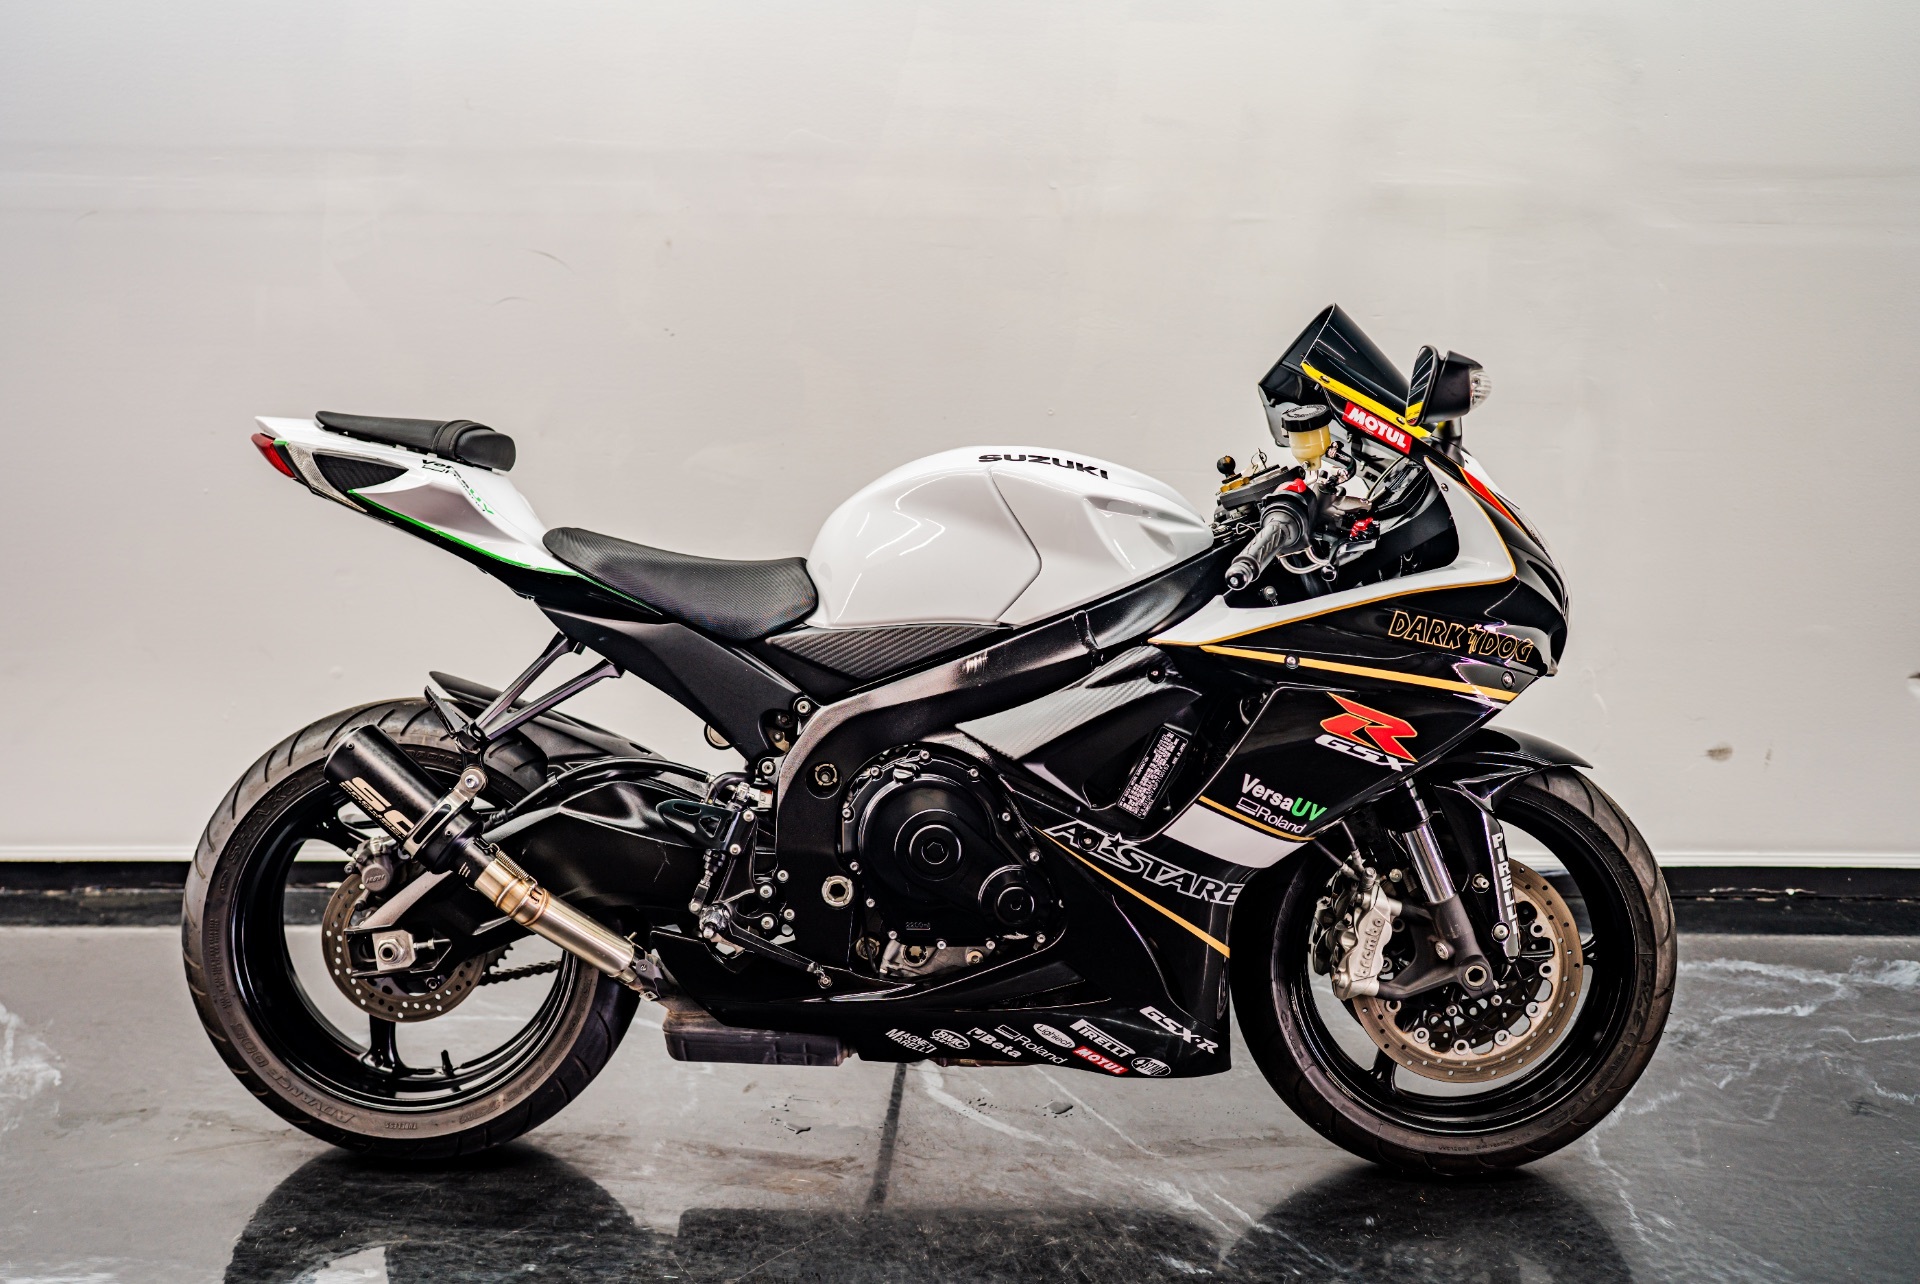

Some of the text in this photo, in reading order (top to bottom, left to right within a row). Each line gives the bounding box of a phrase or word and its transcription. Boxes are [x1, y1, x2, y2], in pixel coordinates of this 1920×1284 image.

[1348, 407, 1406, 448] MOTUL
[978, 454, 1108, 480] SUZUKI
[1388, 610, 1535, 663] DARK DOG
[1320, 691, 1419, 763] R
[1315, 734, 1415, 772] GSX
[344, 776, 415, 837] SC
[1240, 773, 1328, 821] VersaUV
[223, 775, 302, 865] SHINKO
[1255, 805, 1307, 834] Roland
[1491, 832, 1518, 935] PIRELLI
[1354, 918, 1386, 978] brembo
[885, 1028, 937, 1051] MAGNETI
[935, 1030, 966, 1049] BMC
[978, 1032, 1022, 1058] Beta
[1014, 1035, 1068, 1065] Roland
[1069, 1018, 1136, 1058] PIRELLI
[1075, 1047, 1124, 1074] MOTUL
[267, 1066, 355, 1126] ADVANCE
